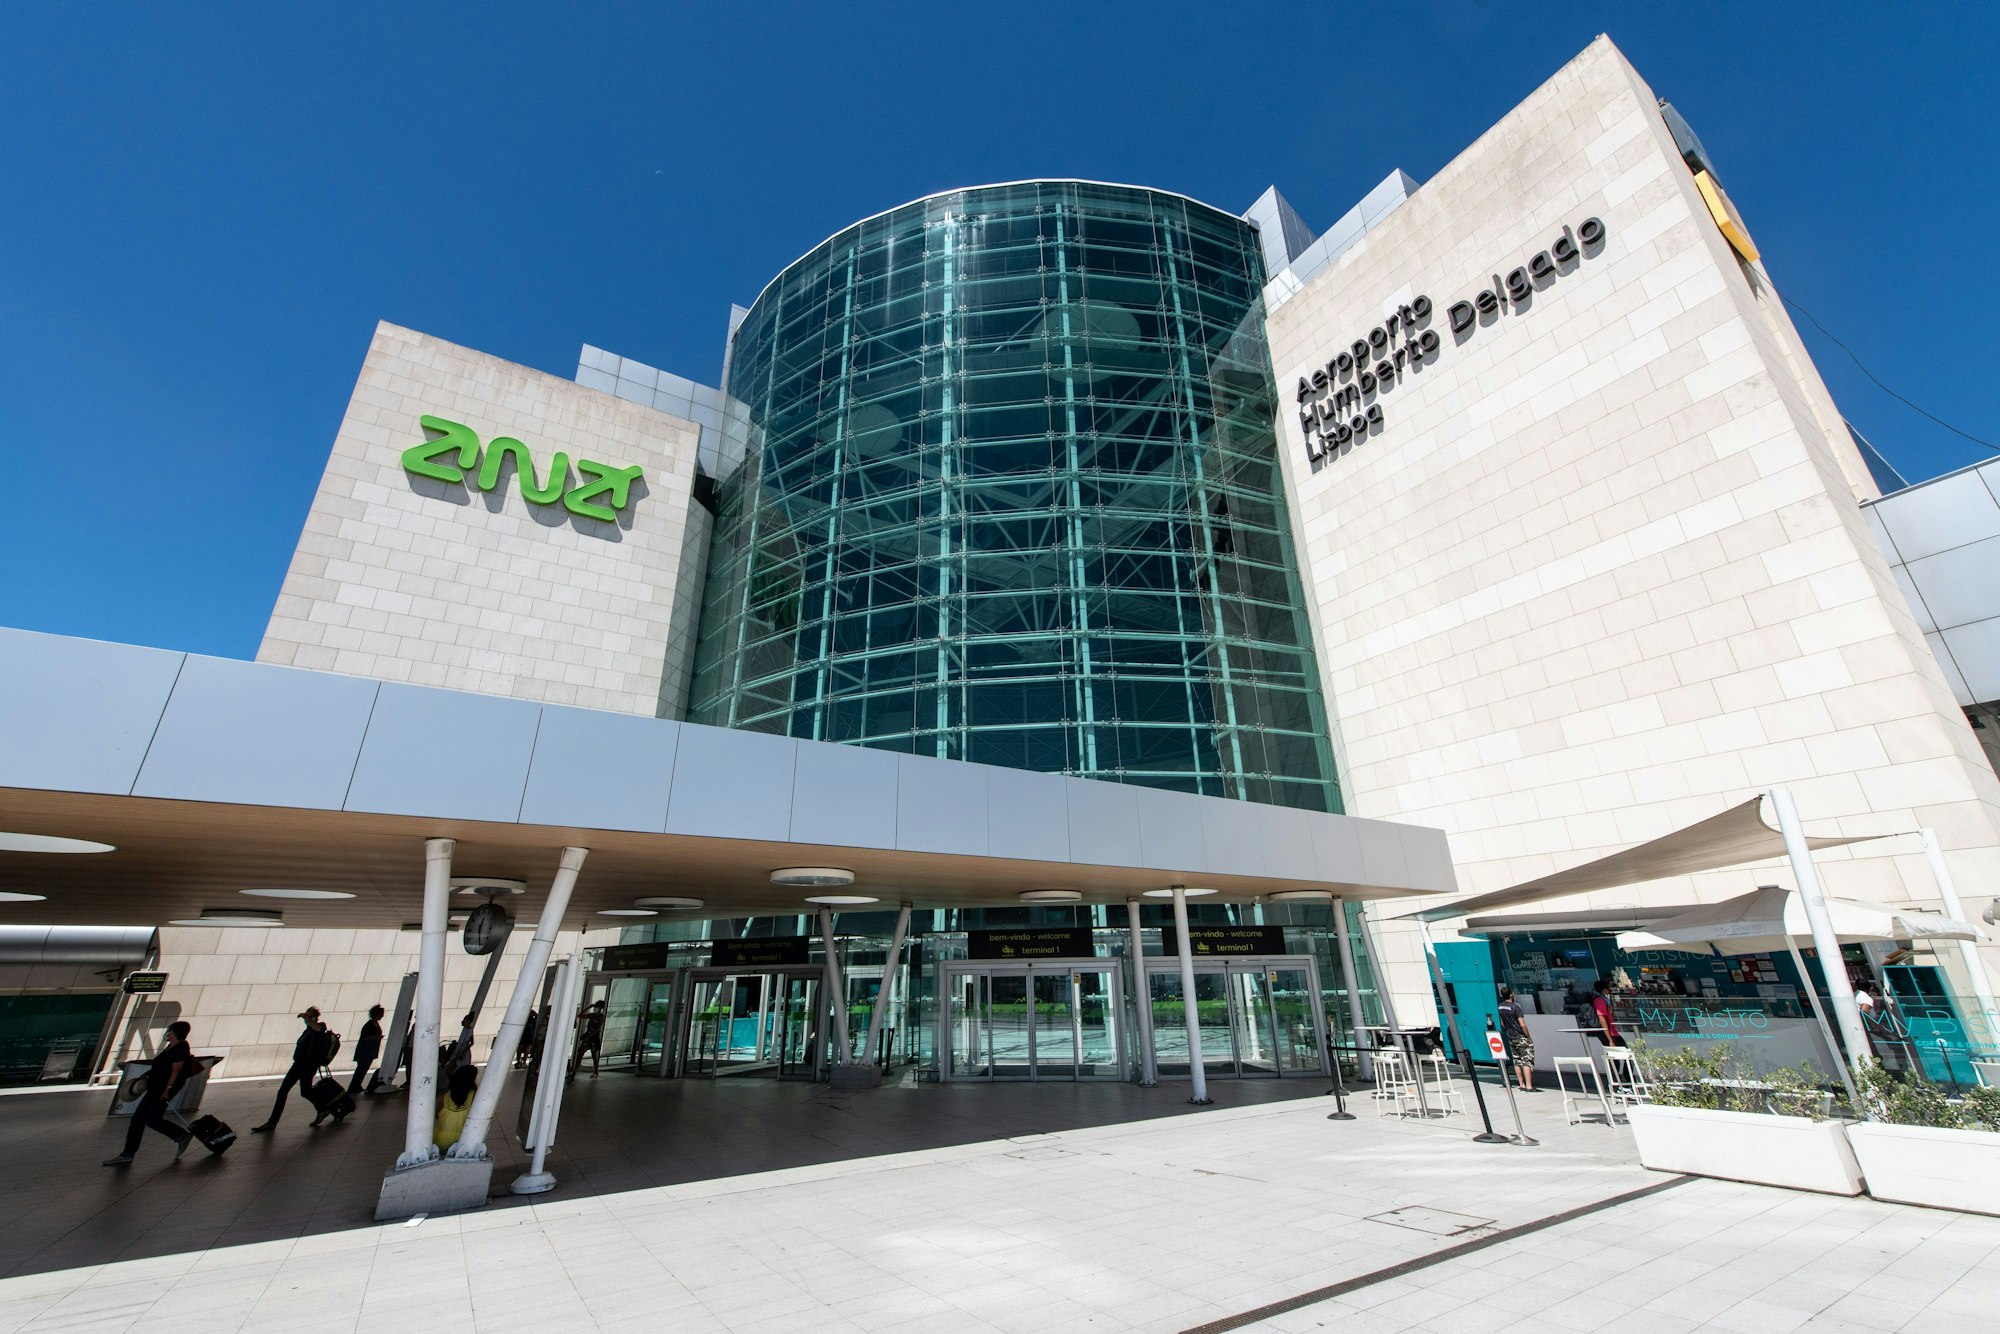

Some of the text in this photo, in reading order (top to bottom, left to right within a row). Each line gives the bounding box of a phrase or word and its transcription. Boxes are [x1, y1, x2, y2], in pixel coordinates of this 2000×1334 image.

[1299, 216, 1605, 433] Humberto Delgado
[1297, 294, 1432, 402] Aeroporto
[1305, 403, 1384, 463] Lisboa
[989, 933, 1031, 941] bem-vindo
[1189, 930, 1224, 938] em-vindo
[752, 953, 777, 961] terminal
[1021, 946, 1054, 954] terminal
[1612, 948, 1639, 964] My
[1639, 1007, 1768, 1031] My Bistro
[1861, 1010, 1912, 1037] My
